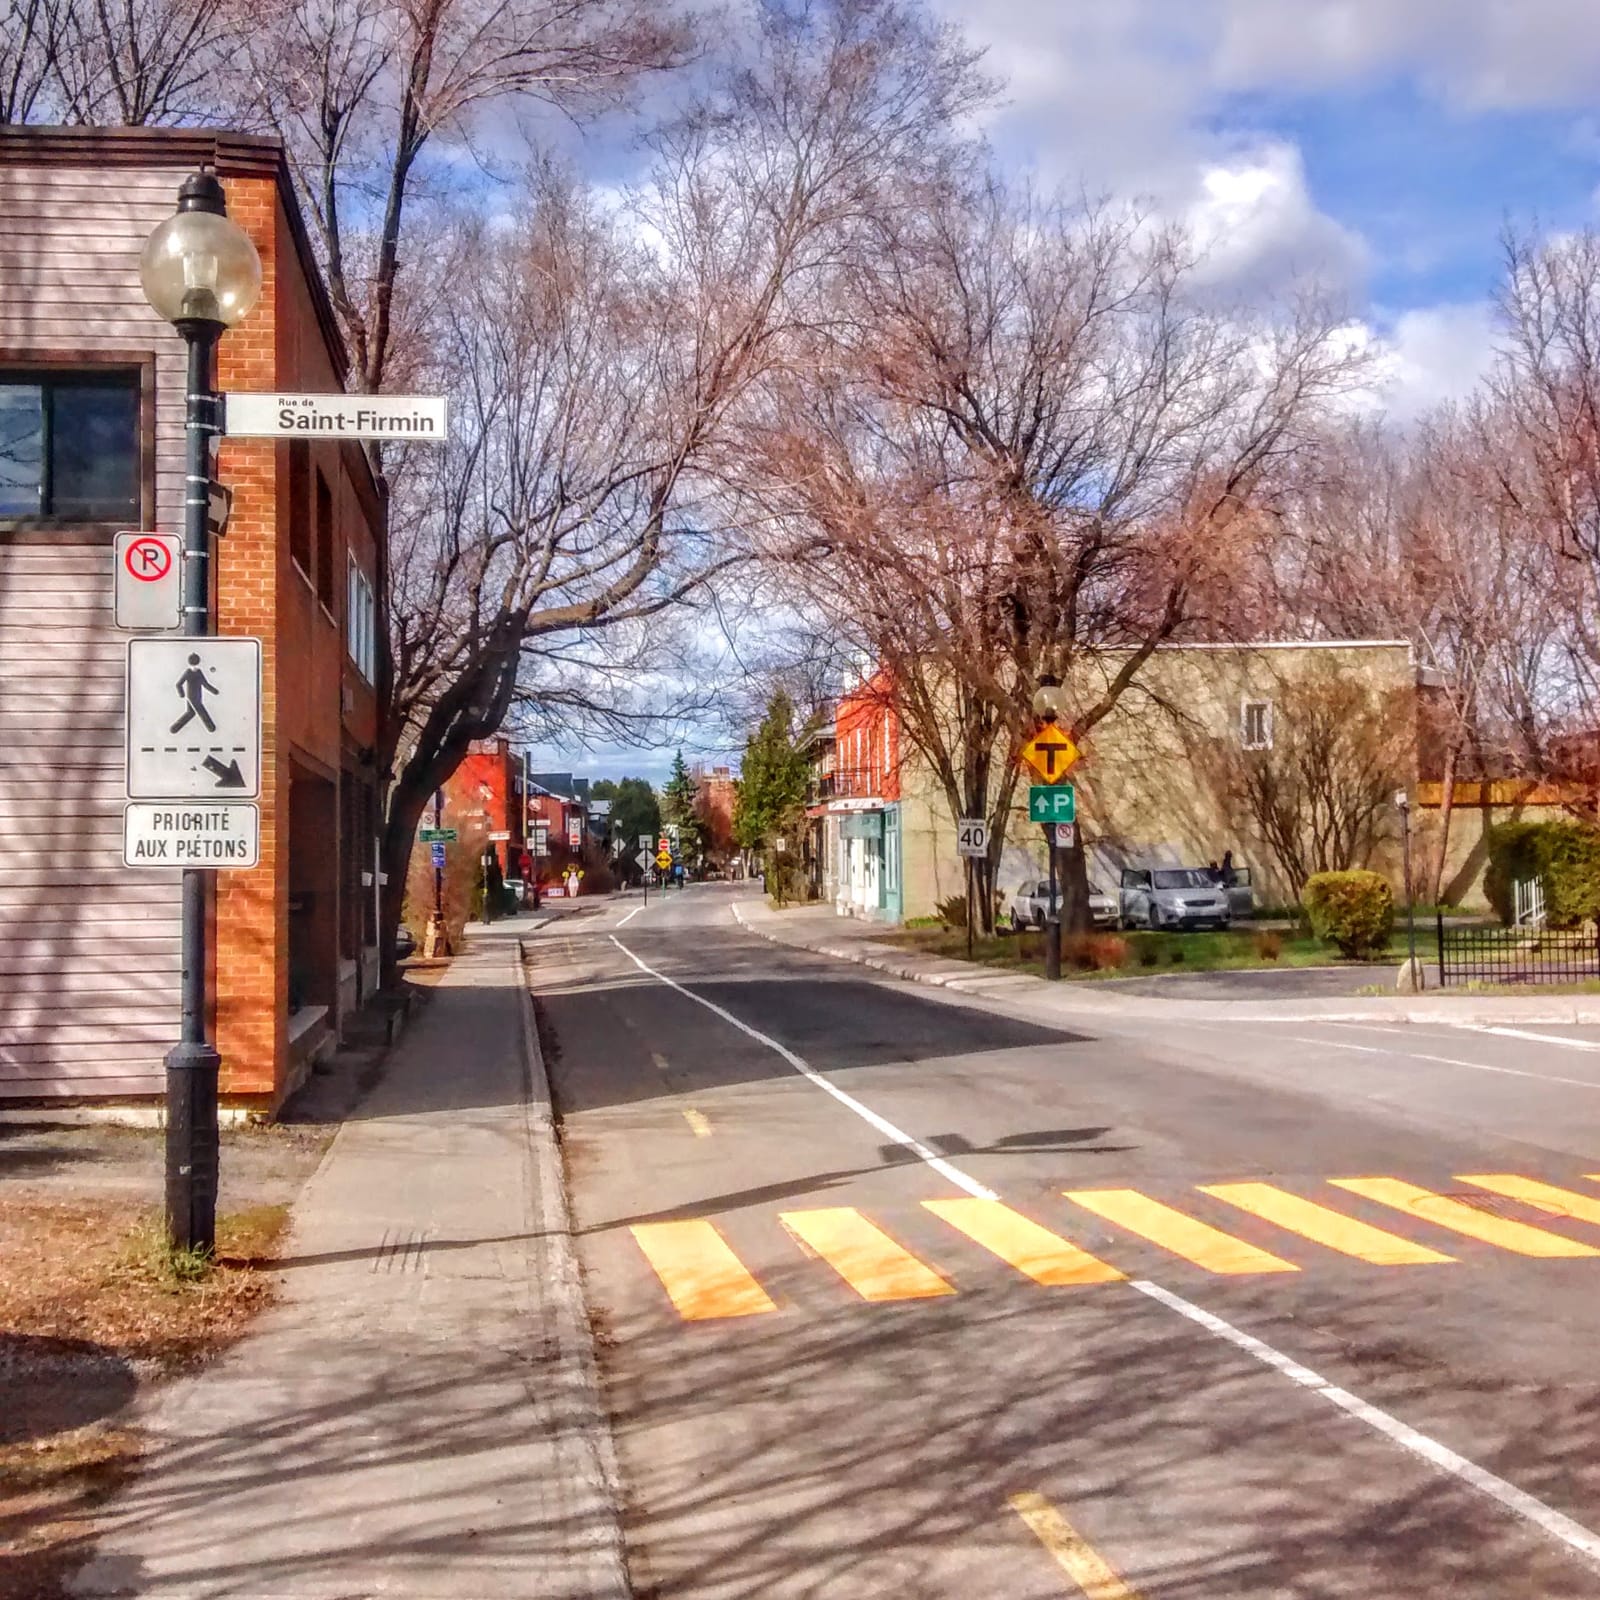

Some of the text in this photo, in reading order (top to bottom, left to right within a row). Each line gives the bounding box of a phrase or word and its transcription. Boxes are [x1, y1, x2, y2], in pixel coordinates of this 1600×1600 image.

[278, 398, 314, 407] Rue de
[278, 409, 434, 432] Saint-Firmin
[142, 548, 159, 571] P
[1053, 793, 1071, 814] P
[153, 807, 230, 831] PRIORITÉ
[135, 833, 248, 858] AUX PIÉTONS
[960, 827, 984, 847] 40
